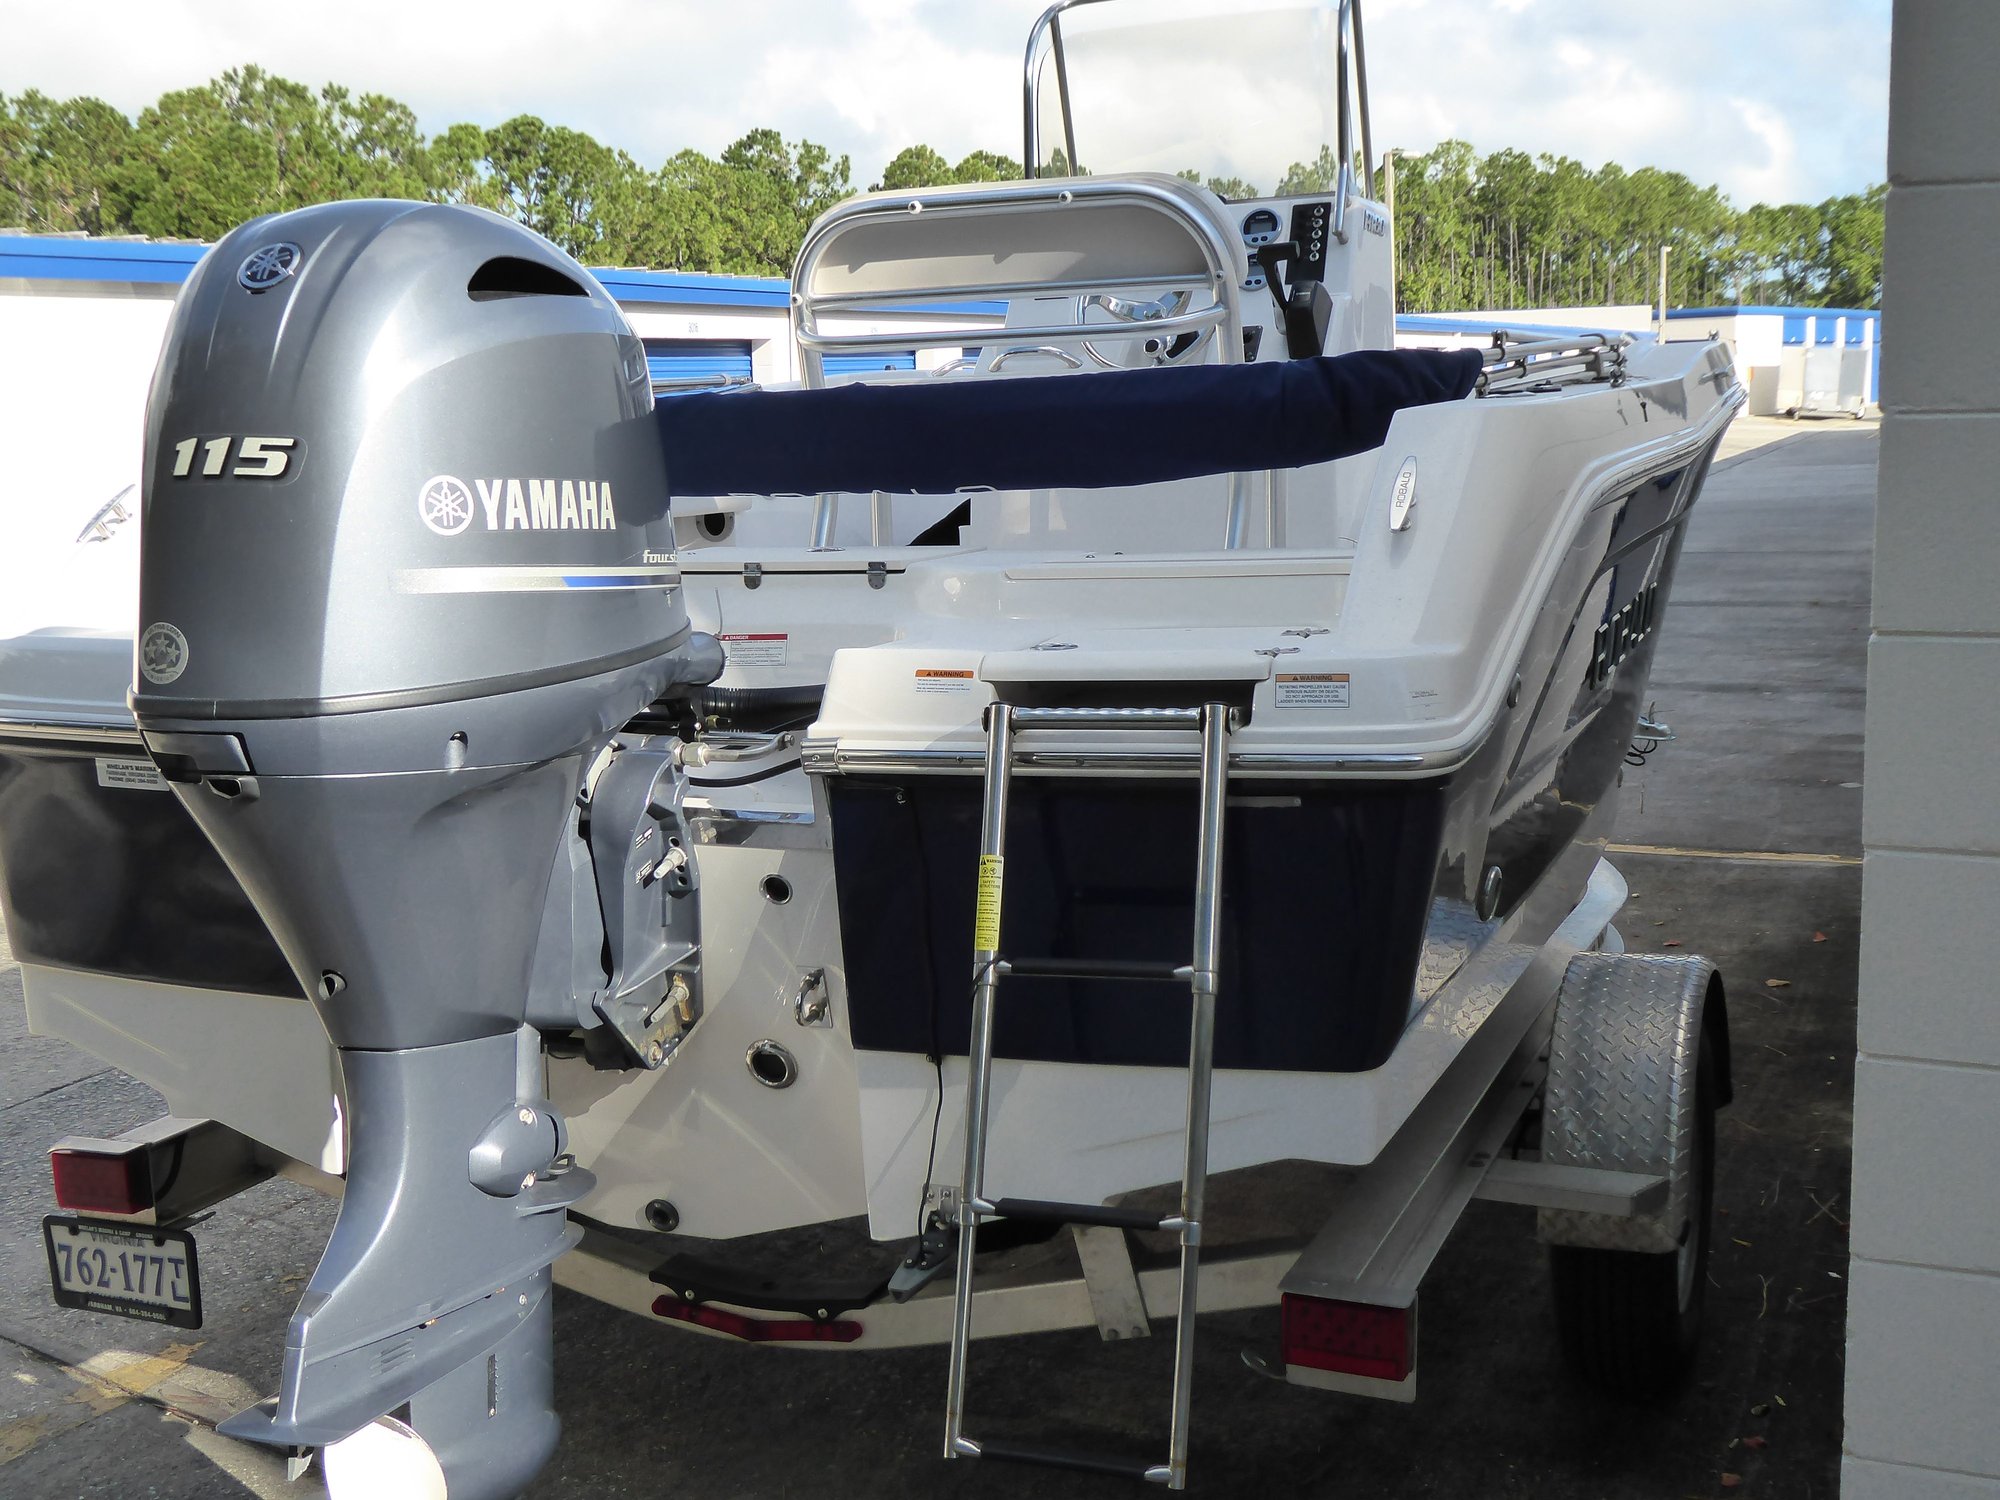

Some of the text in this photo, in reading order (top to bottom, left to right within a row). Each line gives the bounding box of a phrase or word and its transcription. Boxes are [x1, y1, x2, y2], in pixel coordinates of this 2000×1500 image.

[173, 436, 295, 476] 115
[1395, 471, 1412, 508] ROBALO
[474, 479, 617, 531] YAMAHA
[147, 623, 182, 639] ULTRA LOW
[933, 670, 964, 678] WARNING
[90, 1233, 146, 1248] VIRGINIA
[57, 1242, 164, 1297] 762-177
[115, 1303, 123, 1313] VA
